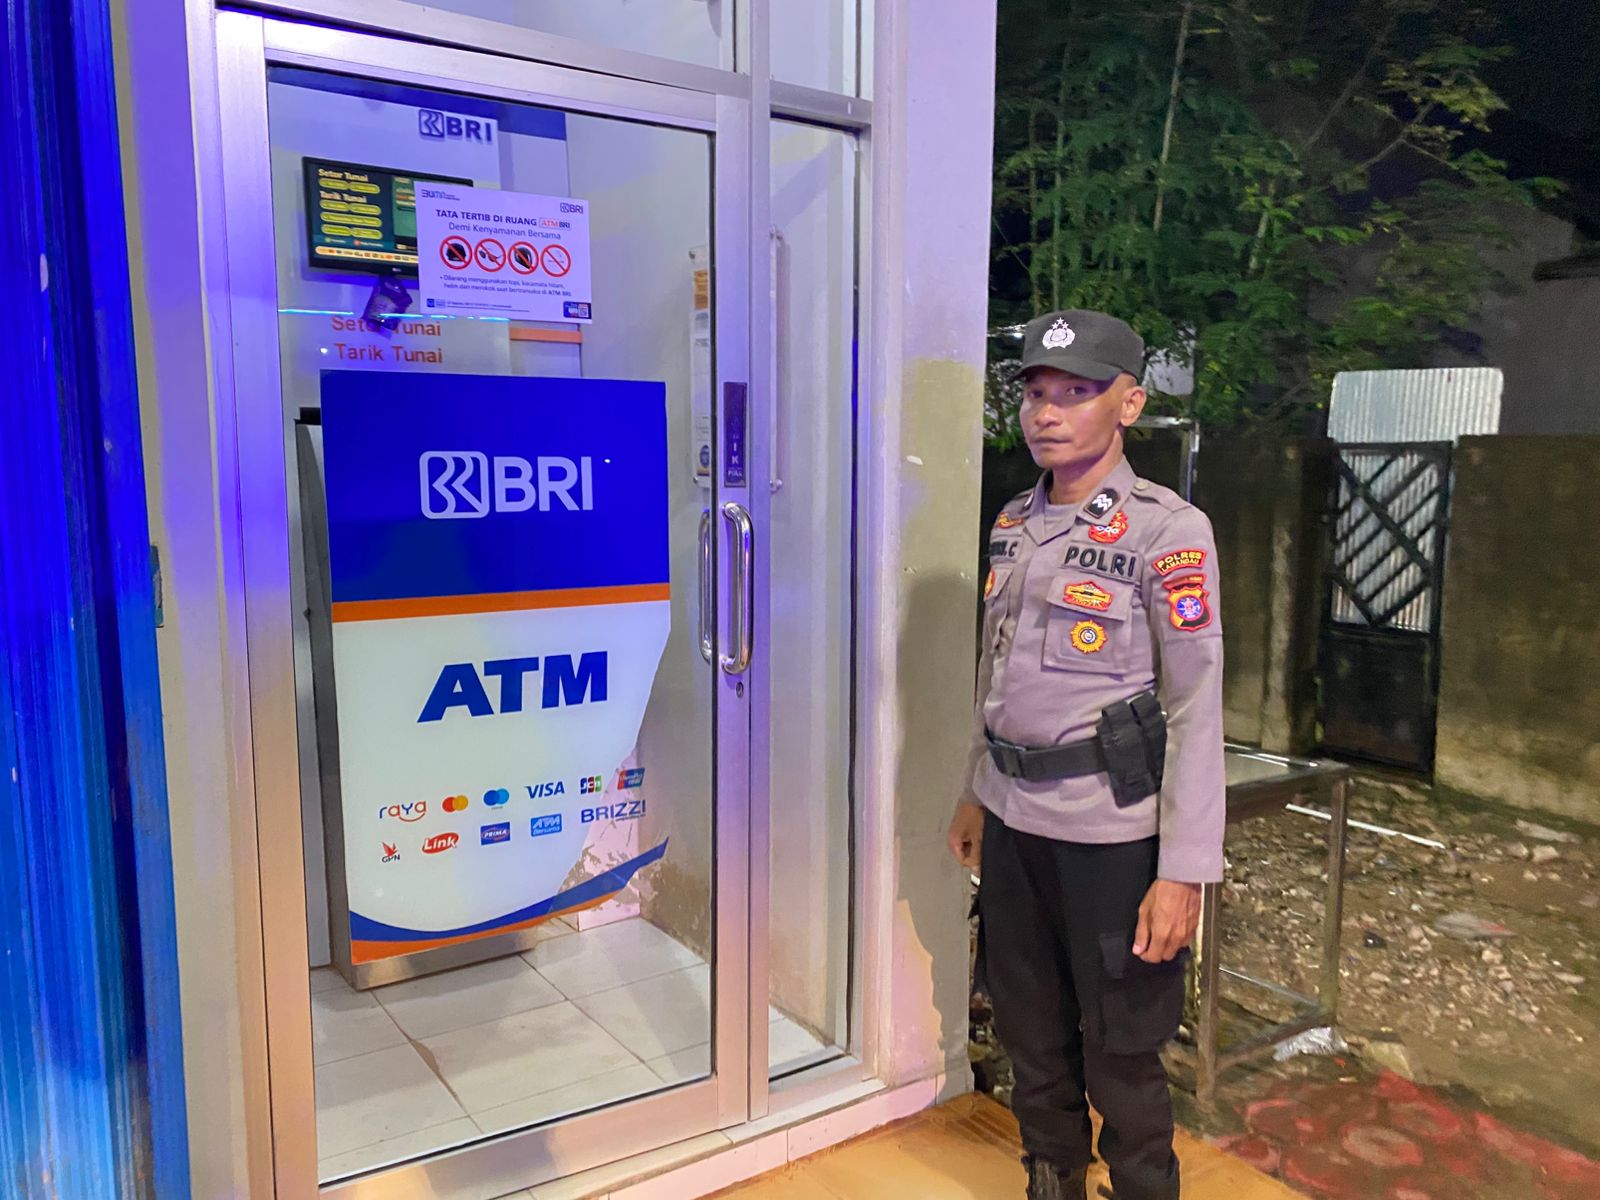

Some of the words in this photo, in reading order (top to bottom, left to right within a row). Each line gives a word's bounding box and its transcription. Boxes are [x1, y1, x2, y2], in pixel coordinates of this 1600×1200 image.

[446, 115, 492, 142] BRI
[436, 209, 458, 219] TATA
[461, 211, 491, 222] TERTIB
[493, 214, 503, 222] DI
[505, 216, 537, 226] RUANG
[449, 222, 471, 232] Demi
[473, 224, 526, 237] Kenyamanan
[528, 229, 561, 240] Bersama
[334, 342, 384, 361] Tarik
[391, 345, 443, 364] Tunai
[493, 456, 594, 512] BRI
[1064, 545, 1137, 577] POLRI
[1157, 551, 1202, 568] POLRES
[416, 650, 608, 723] ATM
[525, 781, 565, 799] VISA
[581, 800, 646, 823] BRIZZI
[532, 816, 560, 829] ATM
[484, 829, 507, 838] PRIMA
[424, 836, 457, 851] Link
